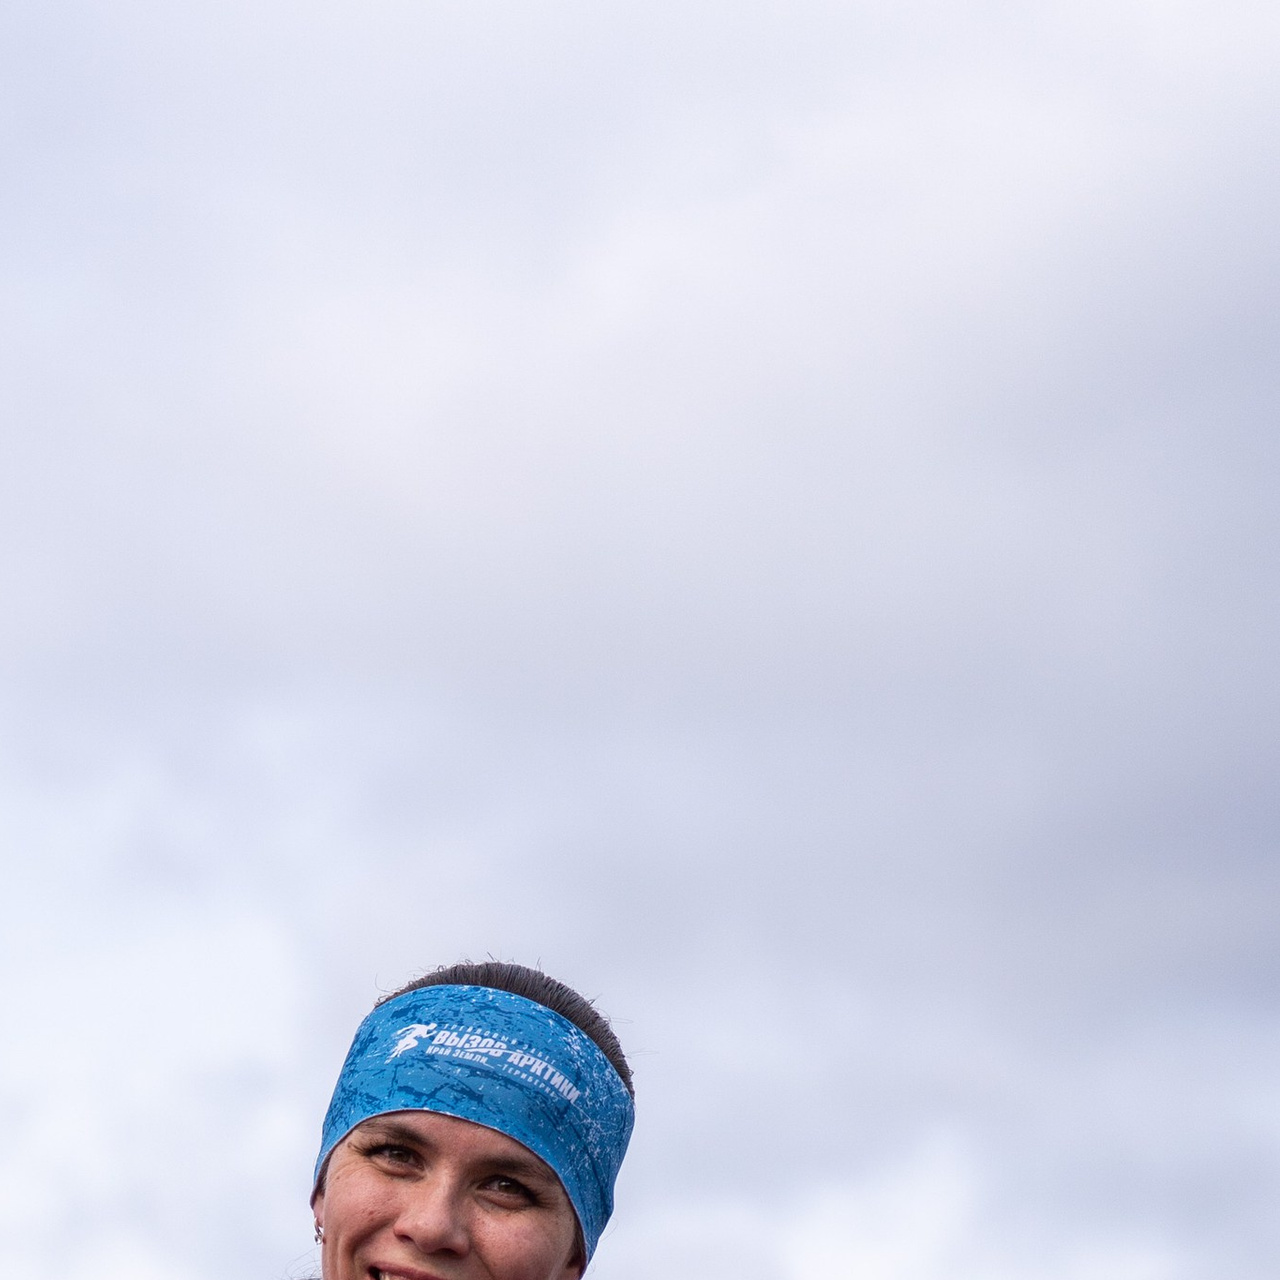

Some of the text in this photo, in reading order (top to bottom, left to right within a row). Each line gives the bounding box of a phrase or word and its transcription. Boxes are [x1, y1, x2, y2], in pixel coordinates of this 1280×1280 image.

[426, 1045, 451, 1057] КРАЙ
[452, 1050, 490, 1066] ЗЕМЛИ
[431, 1030, 582, 1102] ВЫЗОВ АРКТИКИ
